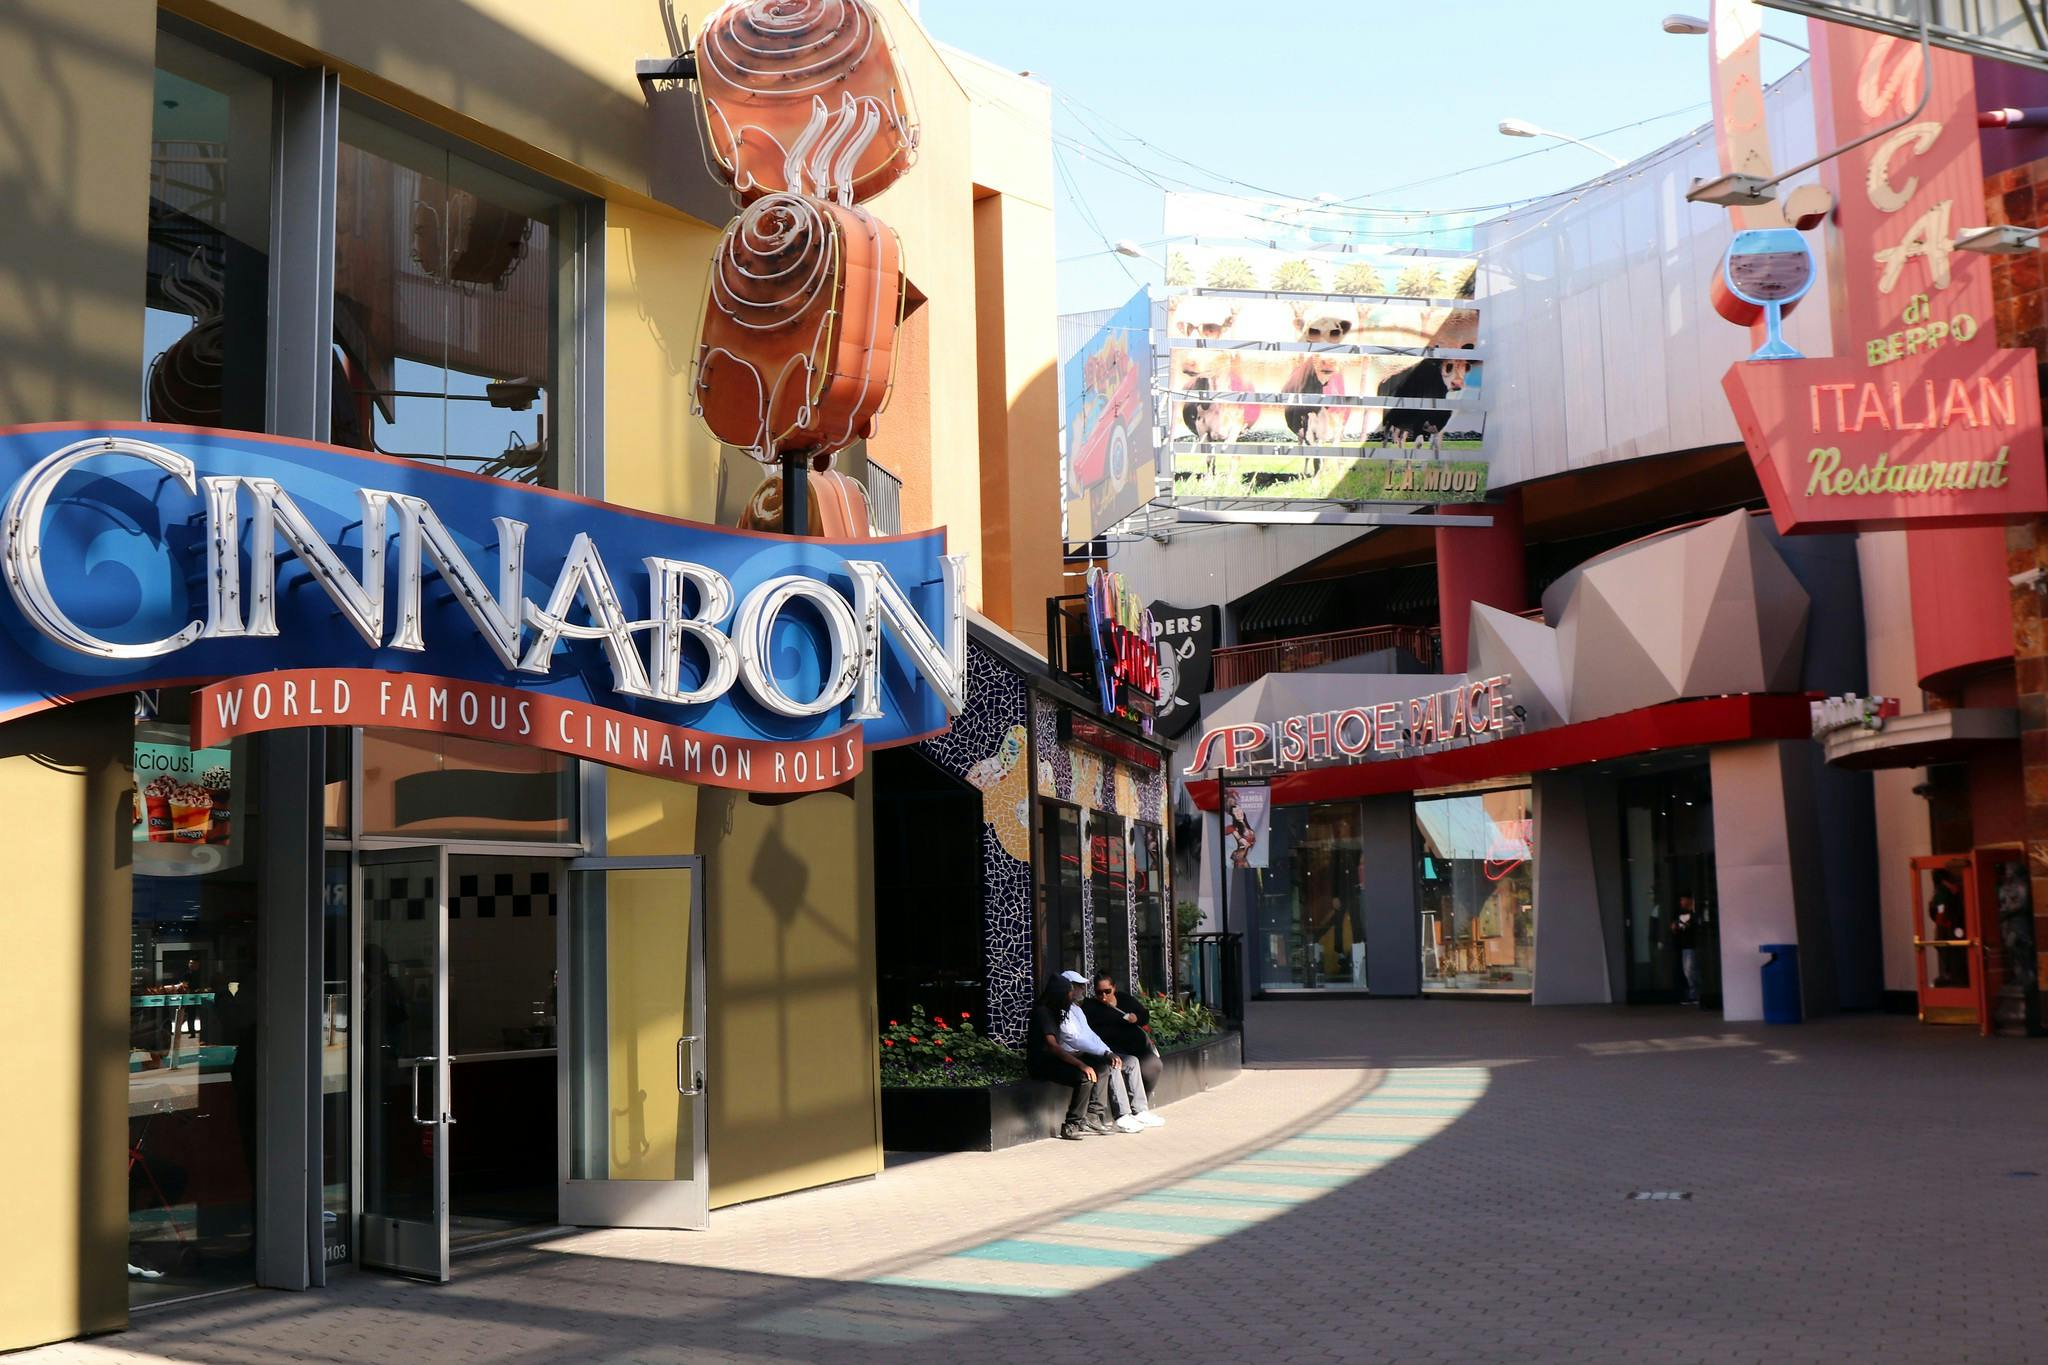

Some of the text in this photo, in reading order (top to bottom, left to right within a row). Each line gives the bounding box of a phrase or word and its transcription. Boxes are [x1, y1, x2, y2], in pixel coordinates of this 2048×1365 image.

[1902, 295, 1930, 325] di
[1867, 313, 1977, 367] BEPPO
[1809, 376, 2016, 433] ITALIAN
[1384, 469, 1479, 492] L.A. MOOD
[1804, 447, 2010, 497] Restaurant
[1, 436, 968, 720] CINNABON
[1150, 615, 1202, 637] DERS
[216, 679, 855, 785] WORLD FAMOUS CINNAMON ROLLS
[1281, 702, 1402, 763] SHOE
[1408, 674, 1510, 746] PALACE
[134, 748, 194, 773] icious!
